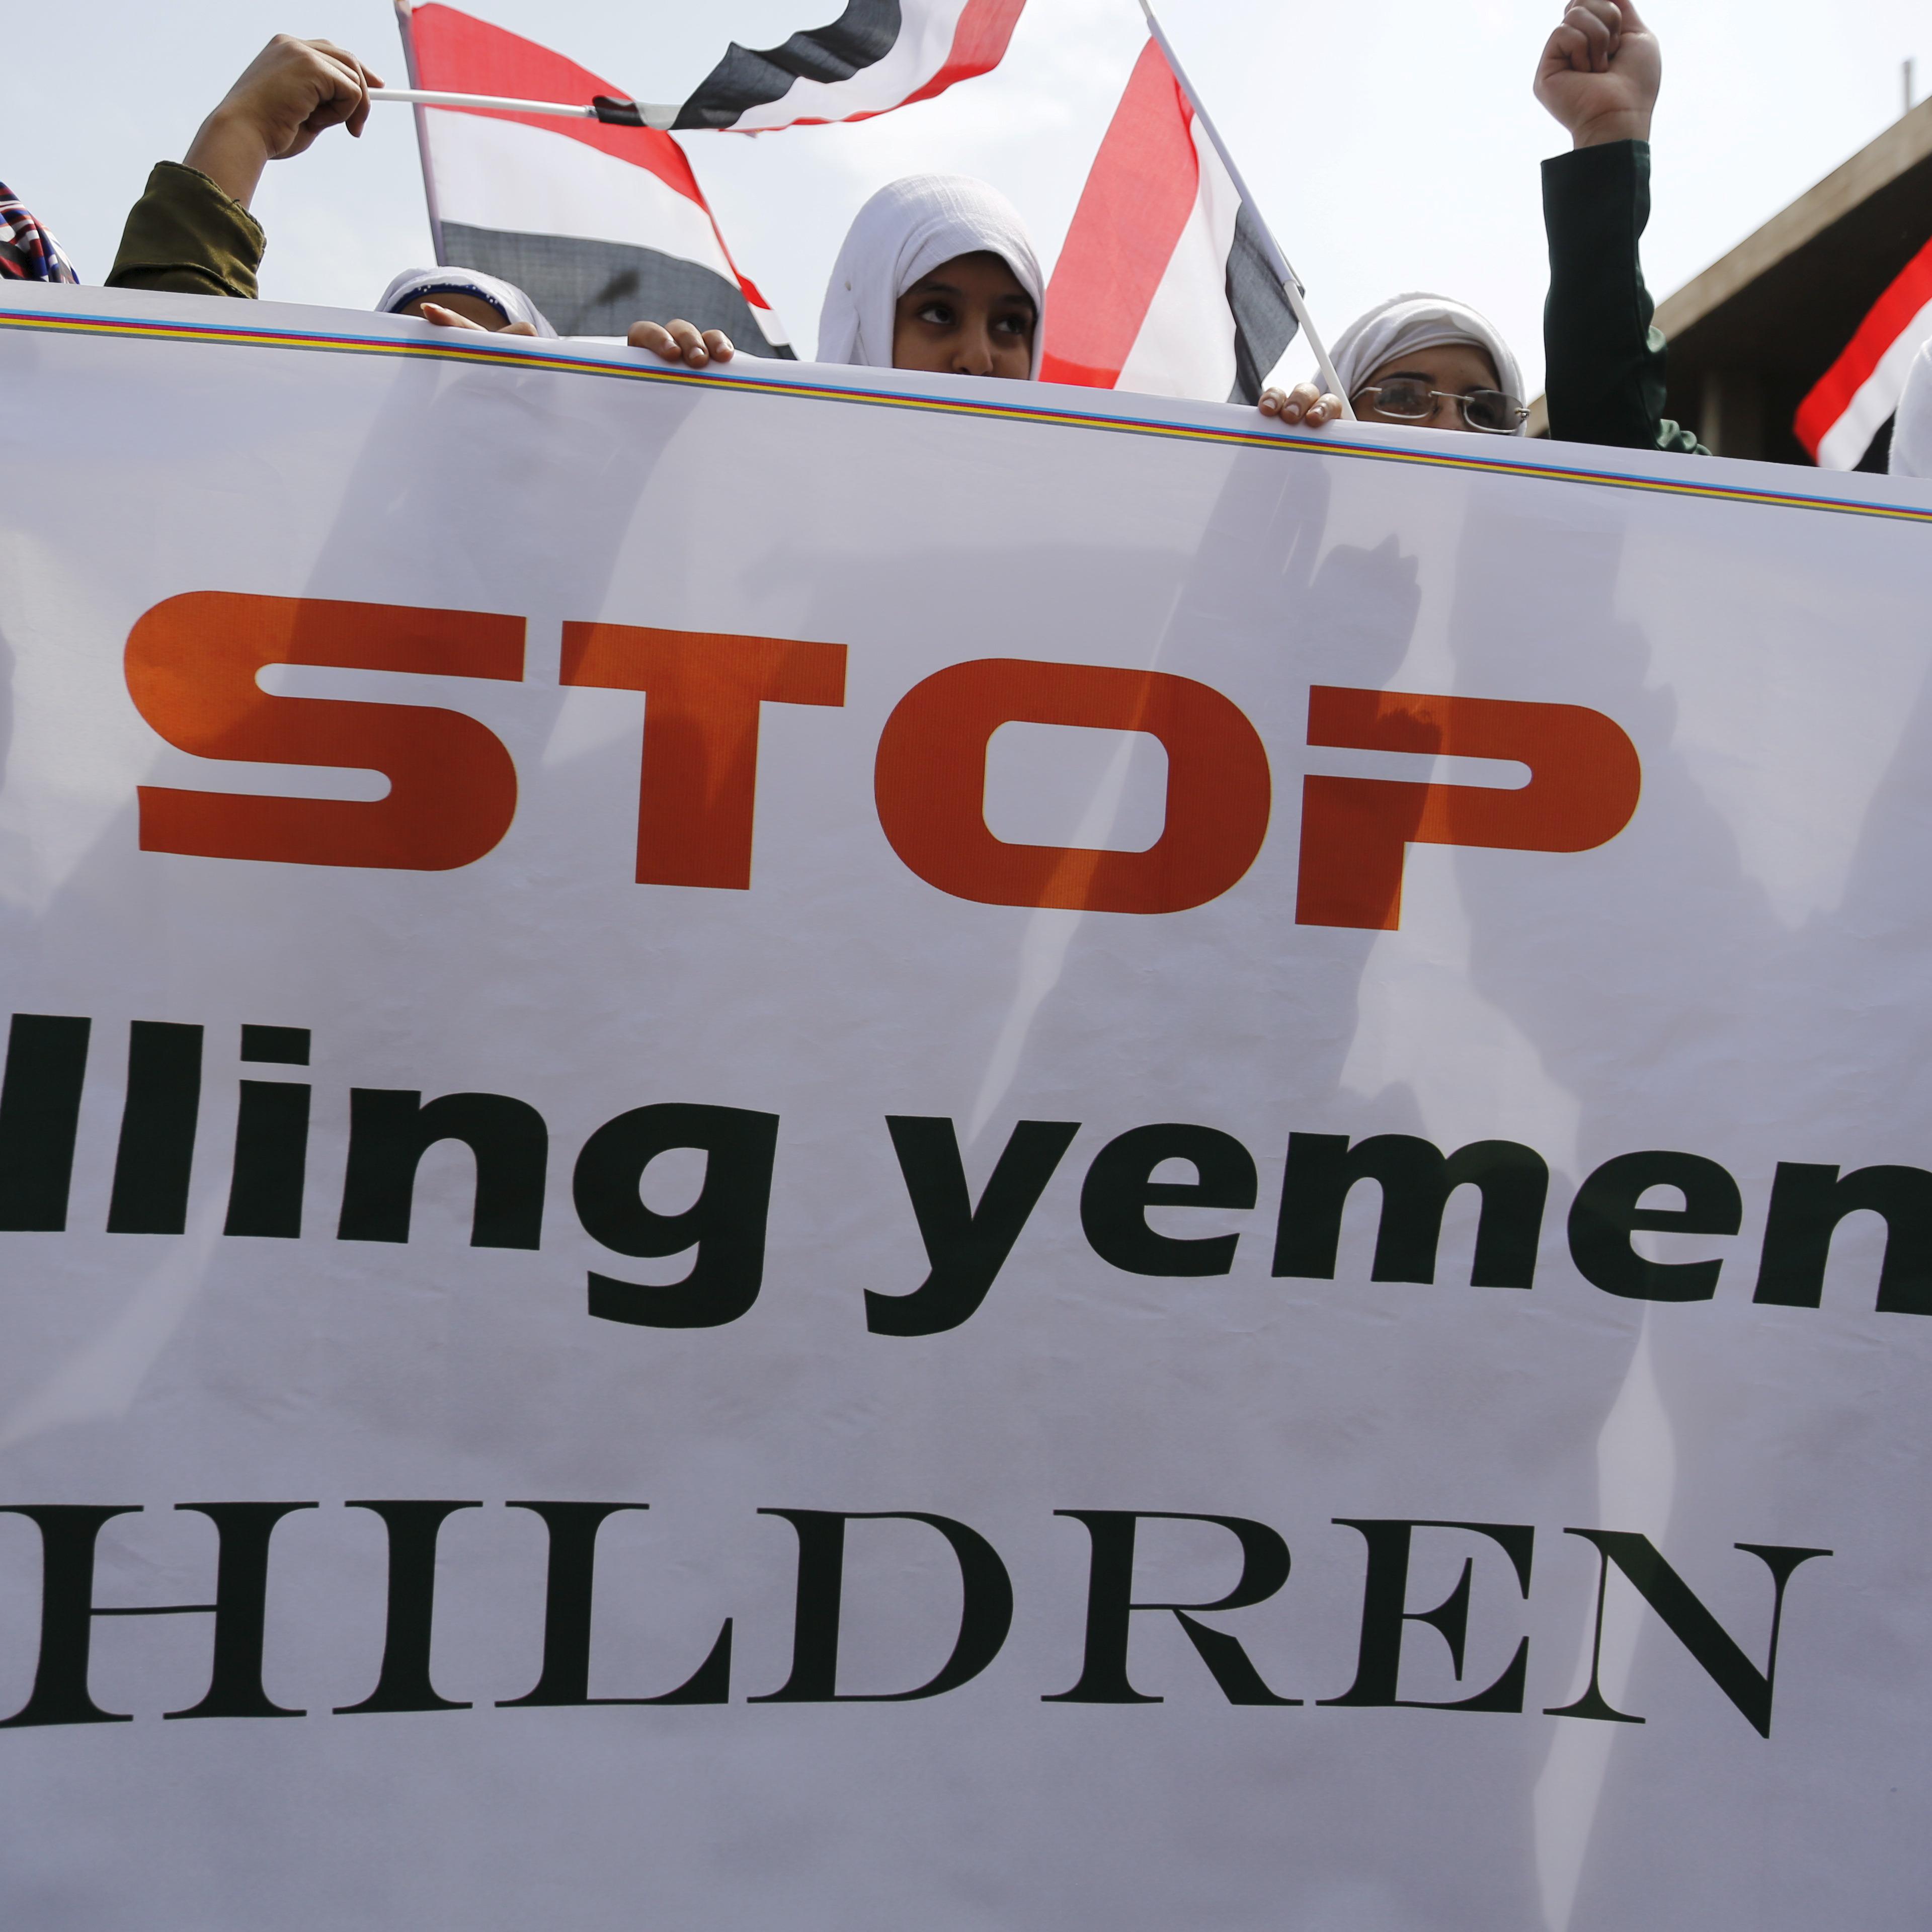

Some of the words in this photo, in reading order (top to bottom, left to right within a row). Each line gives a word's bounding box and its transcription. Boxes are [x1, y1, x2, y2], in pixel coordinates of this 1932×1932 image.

[125, 591, 1641, 930] STOP
[864, 1115, 1932, 1337] yemen
[0, 1500, 1833, 1739] HILDREN
